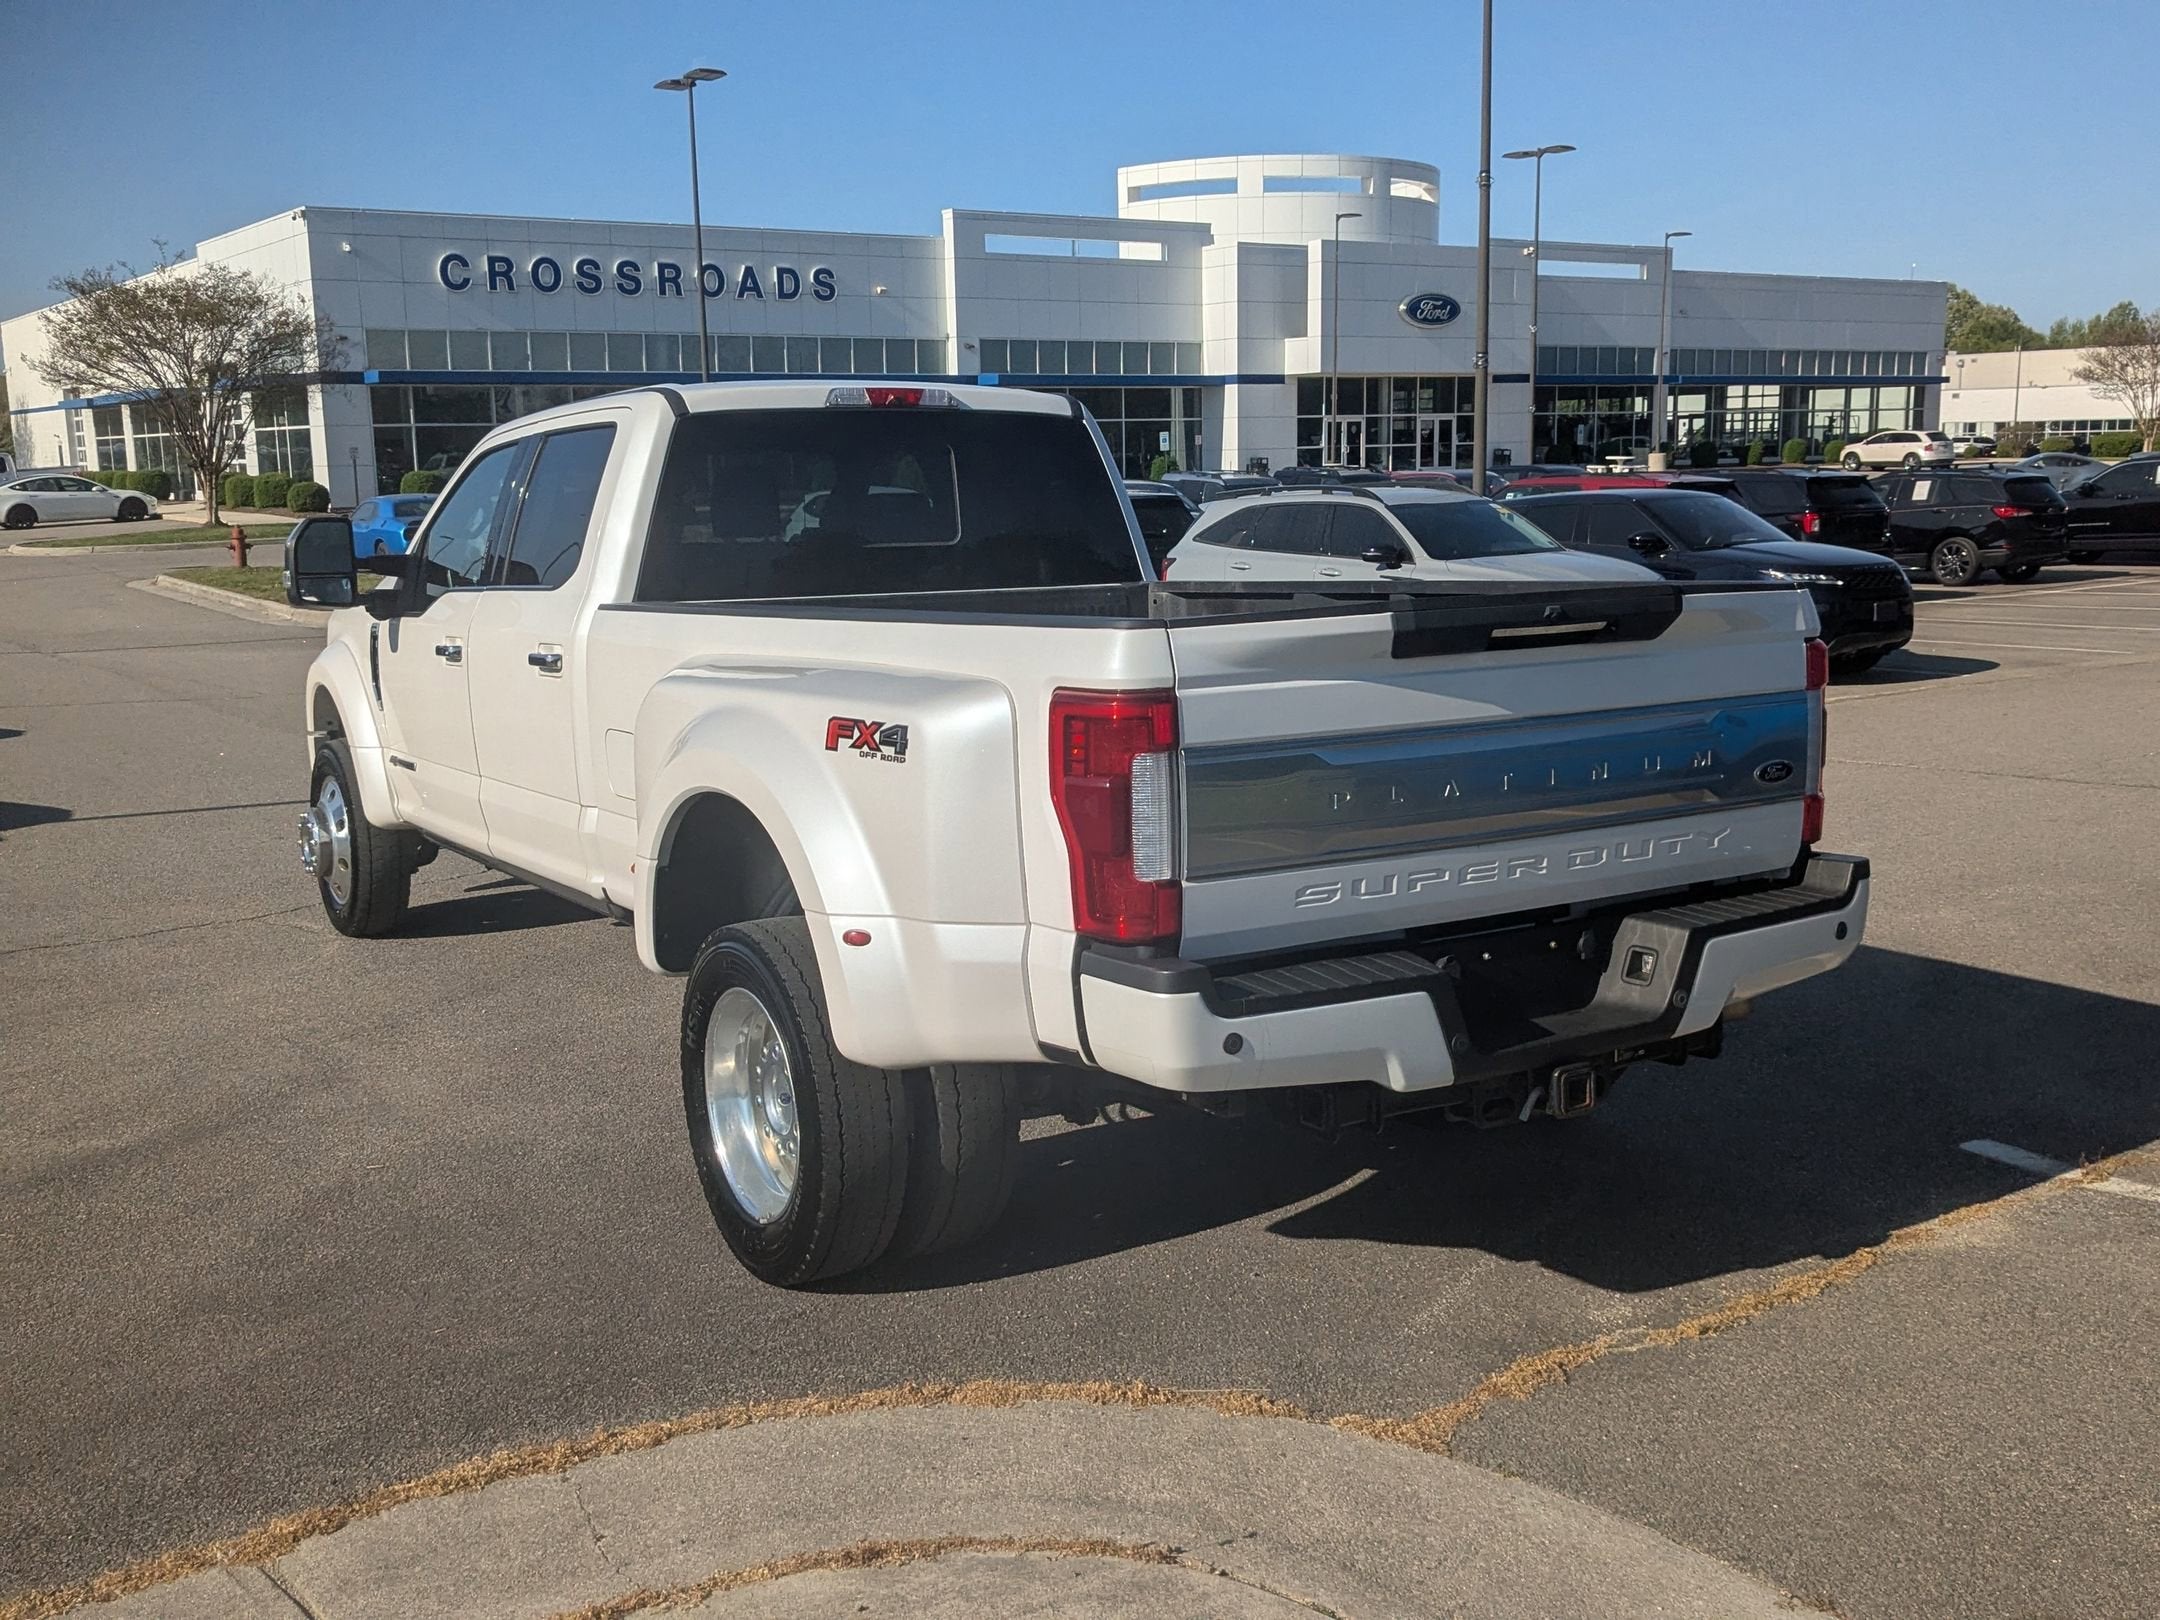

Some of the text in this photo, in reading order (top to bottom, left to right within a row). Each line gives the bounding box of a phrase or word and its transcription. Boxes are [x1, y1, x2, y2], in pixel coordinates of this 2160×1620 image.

[438, 253, 838, 302] CROSSROADS
[1416, 299, 1451, 320] Ford
[825, 716, 909, 756] FX4
[859, 750, 906, 764] OFF ROAD
[1332, 750, 1713, 810] PLATINUM
[1294, 827, 1731, 909] SUPER DUTY
